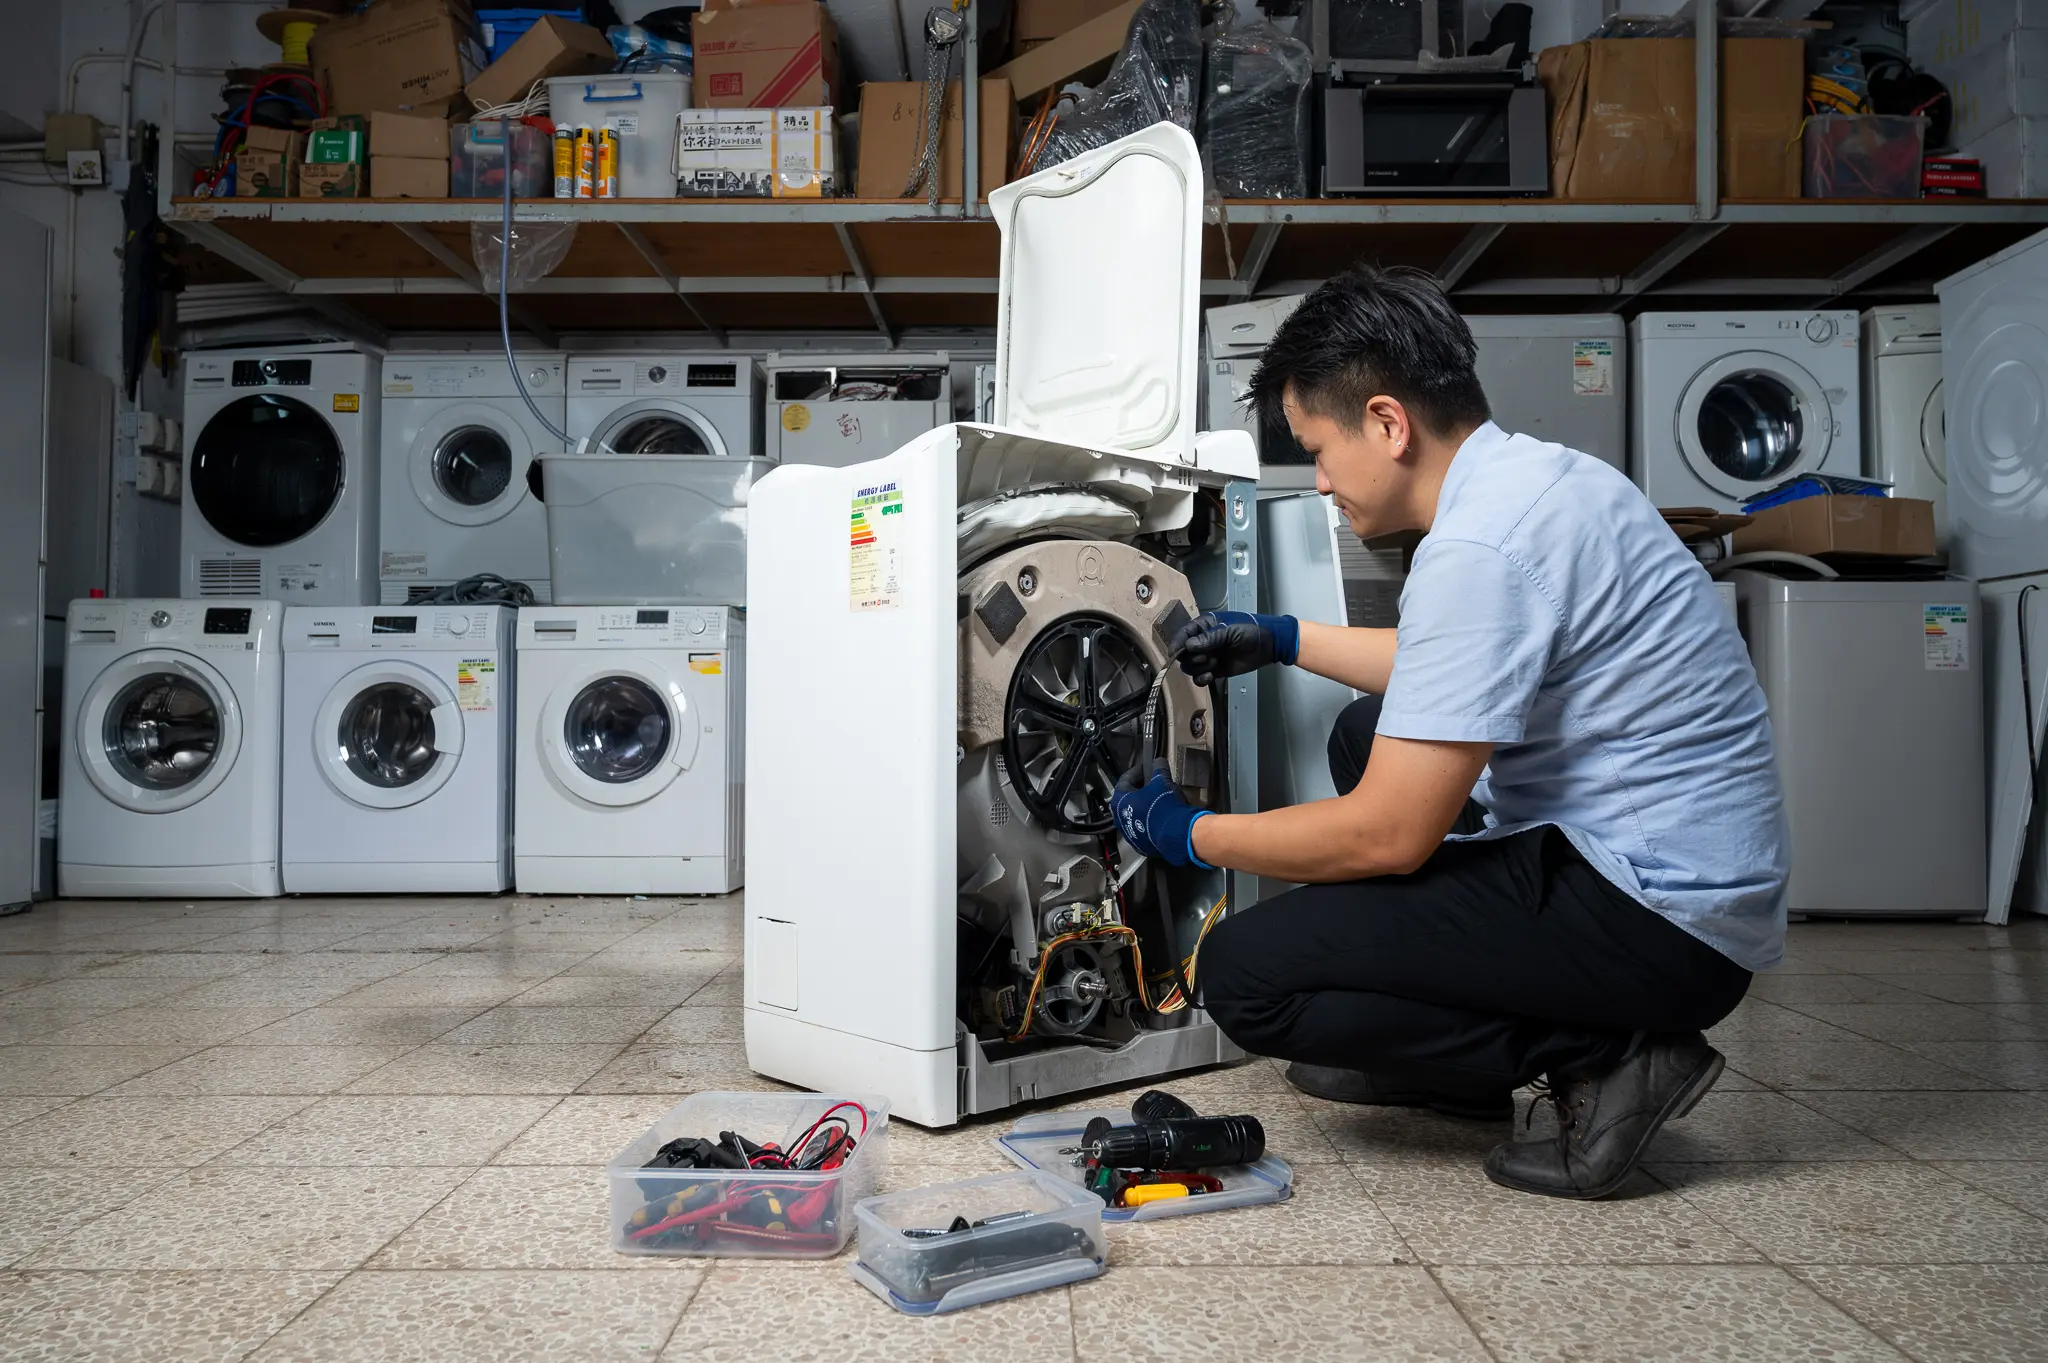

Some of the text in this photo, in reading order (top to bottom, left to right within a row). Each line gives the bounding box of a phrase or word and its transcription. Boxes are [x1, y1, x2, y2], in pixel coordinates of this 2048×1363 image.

[401, 68, 450, 90] ANTMINER
[783, 114, 809, 127] 精品
[857, 482, 897, 498] ENERGY LABEL
